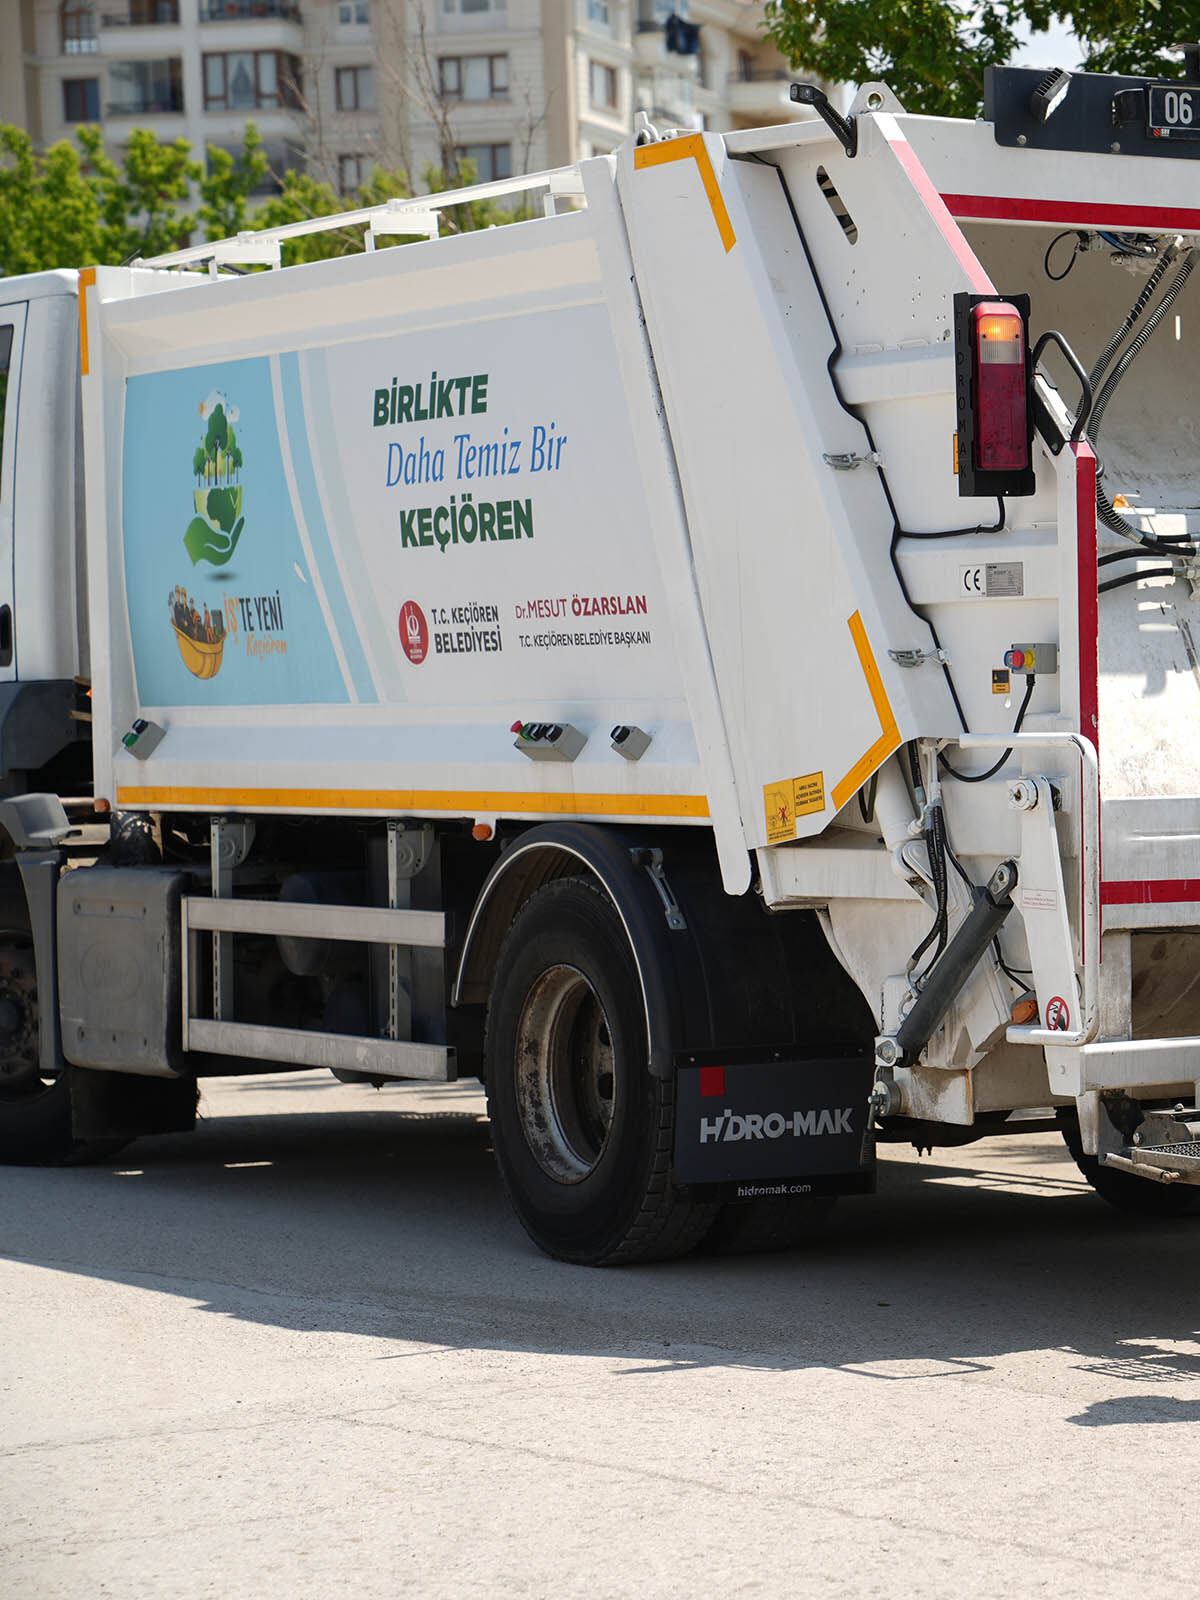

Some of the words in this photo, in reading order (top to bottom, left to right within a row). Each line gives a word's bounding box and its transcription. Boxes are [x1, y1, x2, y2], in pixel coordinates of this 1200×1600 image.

[1164, 91, 1193, 125] 06
[373, 371, 489, 427] BİRLİKTE
[386, 436, 445, 488] Daha
[453, 427, 522, 481] Temiz
[530, 422, 568, 473] Bir
[399, 493, 534, 553] KEÇİÖREN
[254, 589, 284, 631] YENİ
[431, 608, 450, 625] T.C.
[451, 602, 499, 625] KEÇİÖREN
[572, 594, 648, 616] ÖZARSLAN
[246, 633, 288, 664] Keçiören
[434, 624, 503, 654] BELEDİYESİ
[519, 635, 533, 648] T.C.
[534, 630, 573, 650] KEÇİÖREN
[574, 629, 613, 646] BELEDİYE
[614, 631, 651, 648] BAŞKANI
[700, 1109, 853, 1144] HİDRO-MAK
[737, 1184, 812, 1197] hidromak.com
